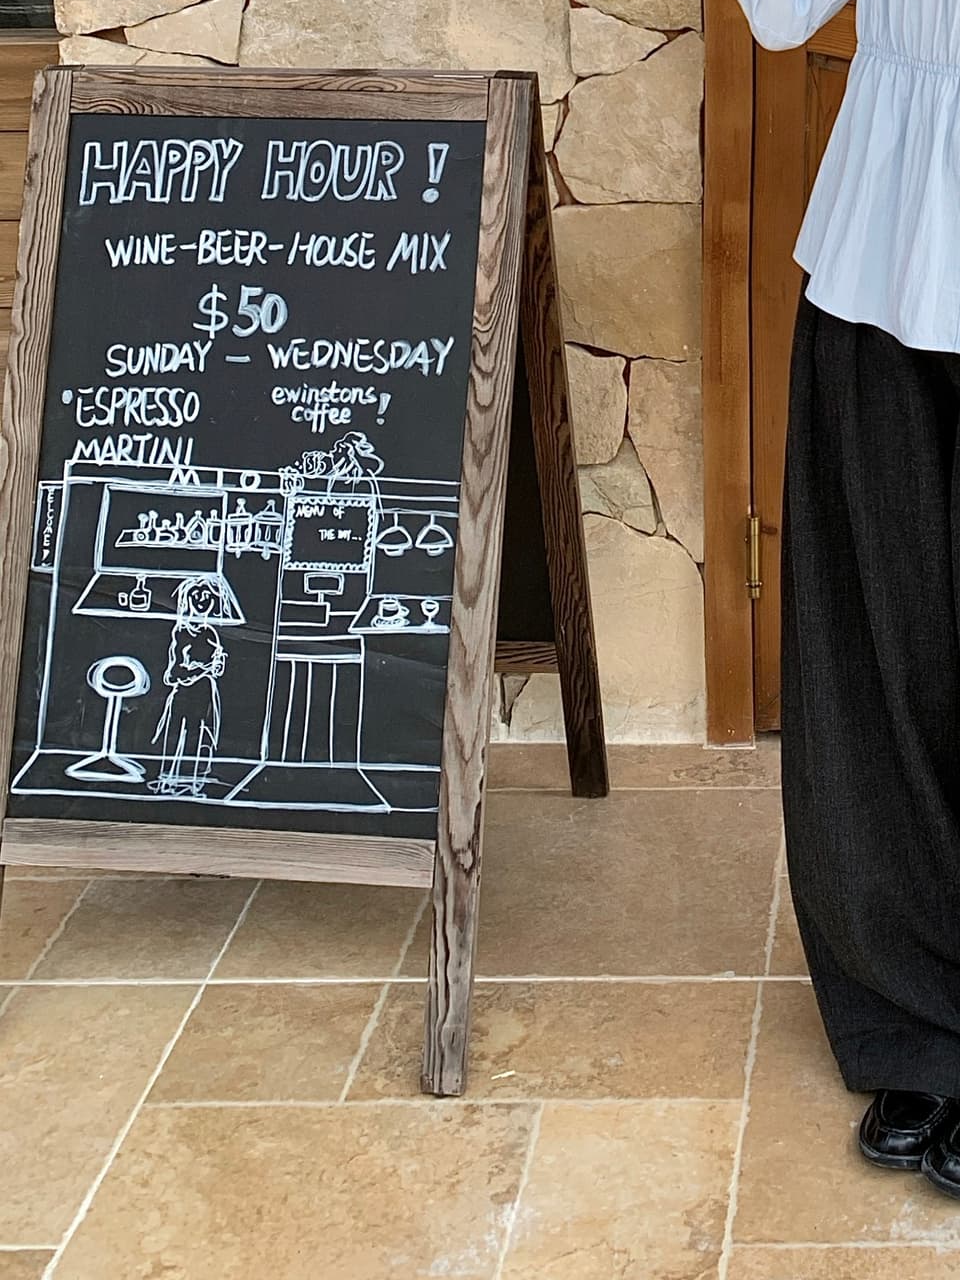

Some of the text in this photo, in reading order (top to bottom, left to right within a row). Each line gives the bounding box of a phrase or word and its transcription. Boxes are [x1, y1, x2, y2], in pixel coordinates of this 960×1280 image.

[79, 138, 244, 205] HAPPY
[261, 140, 405, 202] HOUR
[386, 231, 452, 274] MIX
[193, 283, 289, 339] $50
[104, 340, 213, 378] SUNDAY
[267, 336, 455, 376] WEDNESDAY
[76, 386, 200, 427] ESPRESSO
[291, 403, 352, 433] coffee
[71, 433, 194, 466] MARTINI
[332, 507, 345, 519] OF
[318, 529, 335, 541] THE
